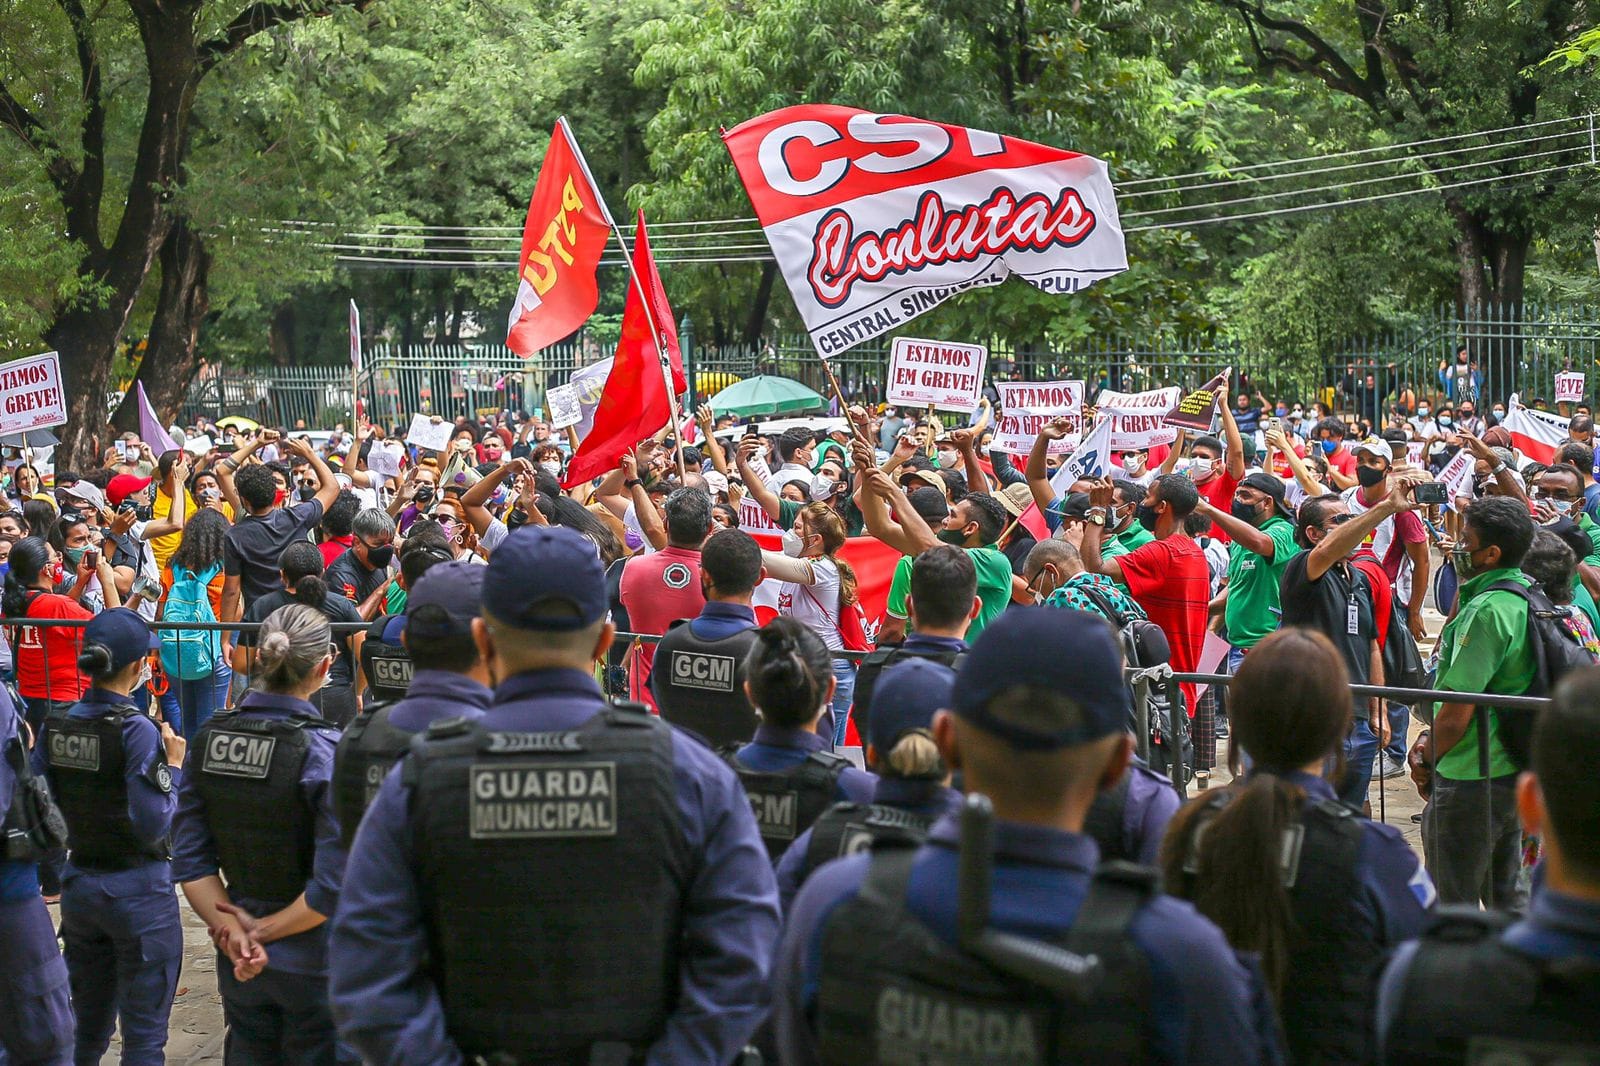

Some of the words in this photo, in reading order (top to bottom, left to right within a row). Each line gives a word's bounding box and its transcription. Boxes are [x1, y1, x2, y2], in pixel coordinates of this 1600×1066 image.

[807, 185, 1096, 309] Conlutas
[819, 307, 900, 353] CENTRAL
[906, 345, 971, 367] ESTAMOS
[0, 364, 48, 392] TAMOS
[896, 368, 917, 385] EM
[921, 370, 975, 391] GREVE!
[5, 387, 58, 414] GREVE!
[1001, 416, 1019, 434] EM
[1023, 415, 1081, 435] GR!
[1121, 414, 1175, 433] GREV
[740, 502, 783, 530] STAM
[676, 655, 730, 682] GCM
[52, 733, 97, 760] GCM
[210, 735, 271, 766] GCM
[476, 770, 609, 799] GUARDA
[476, 800, 611, 830] MUNICIPAL
[877, 985, 1036, 1060] GUARDA
